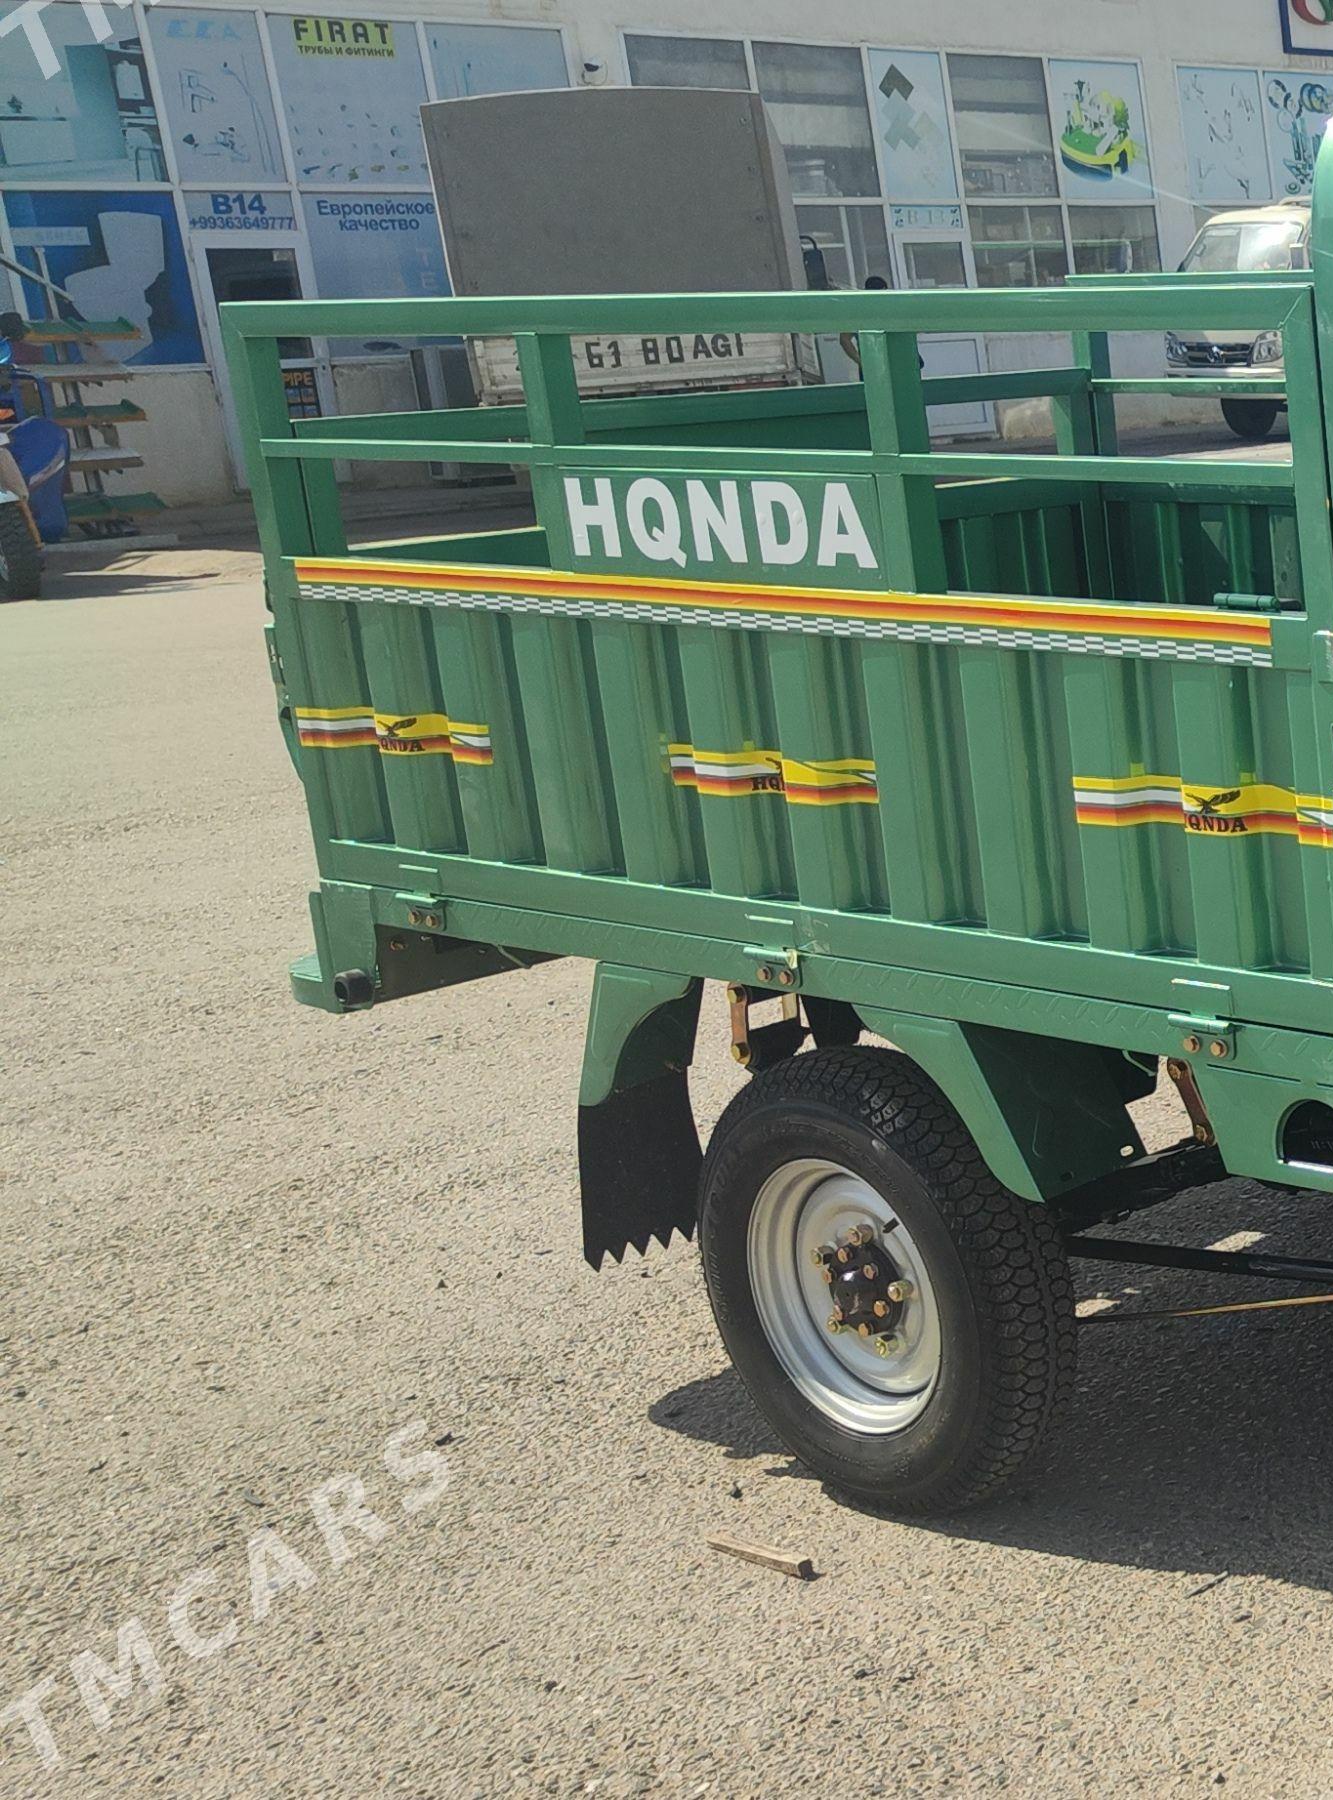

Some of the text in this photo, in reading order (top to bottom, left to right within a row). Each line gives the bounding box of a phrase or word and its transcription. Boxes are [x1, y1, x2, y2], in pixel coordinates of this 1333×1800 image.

[293, 18, 389, 45] FIRAT
[297, 45, 394, 58] ТРУБЫ И ФИТИНГИ
[211, 193, 267, 216] B14
[317, 200, 435, 217] Европейское
[340, 217, 420, 232] качество
[563, 477, 879, 569] HQNDA
